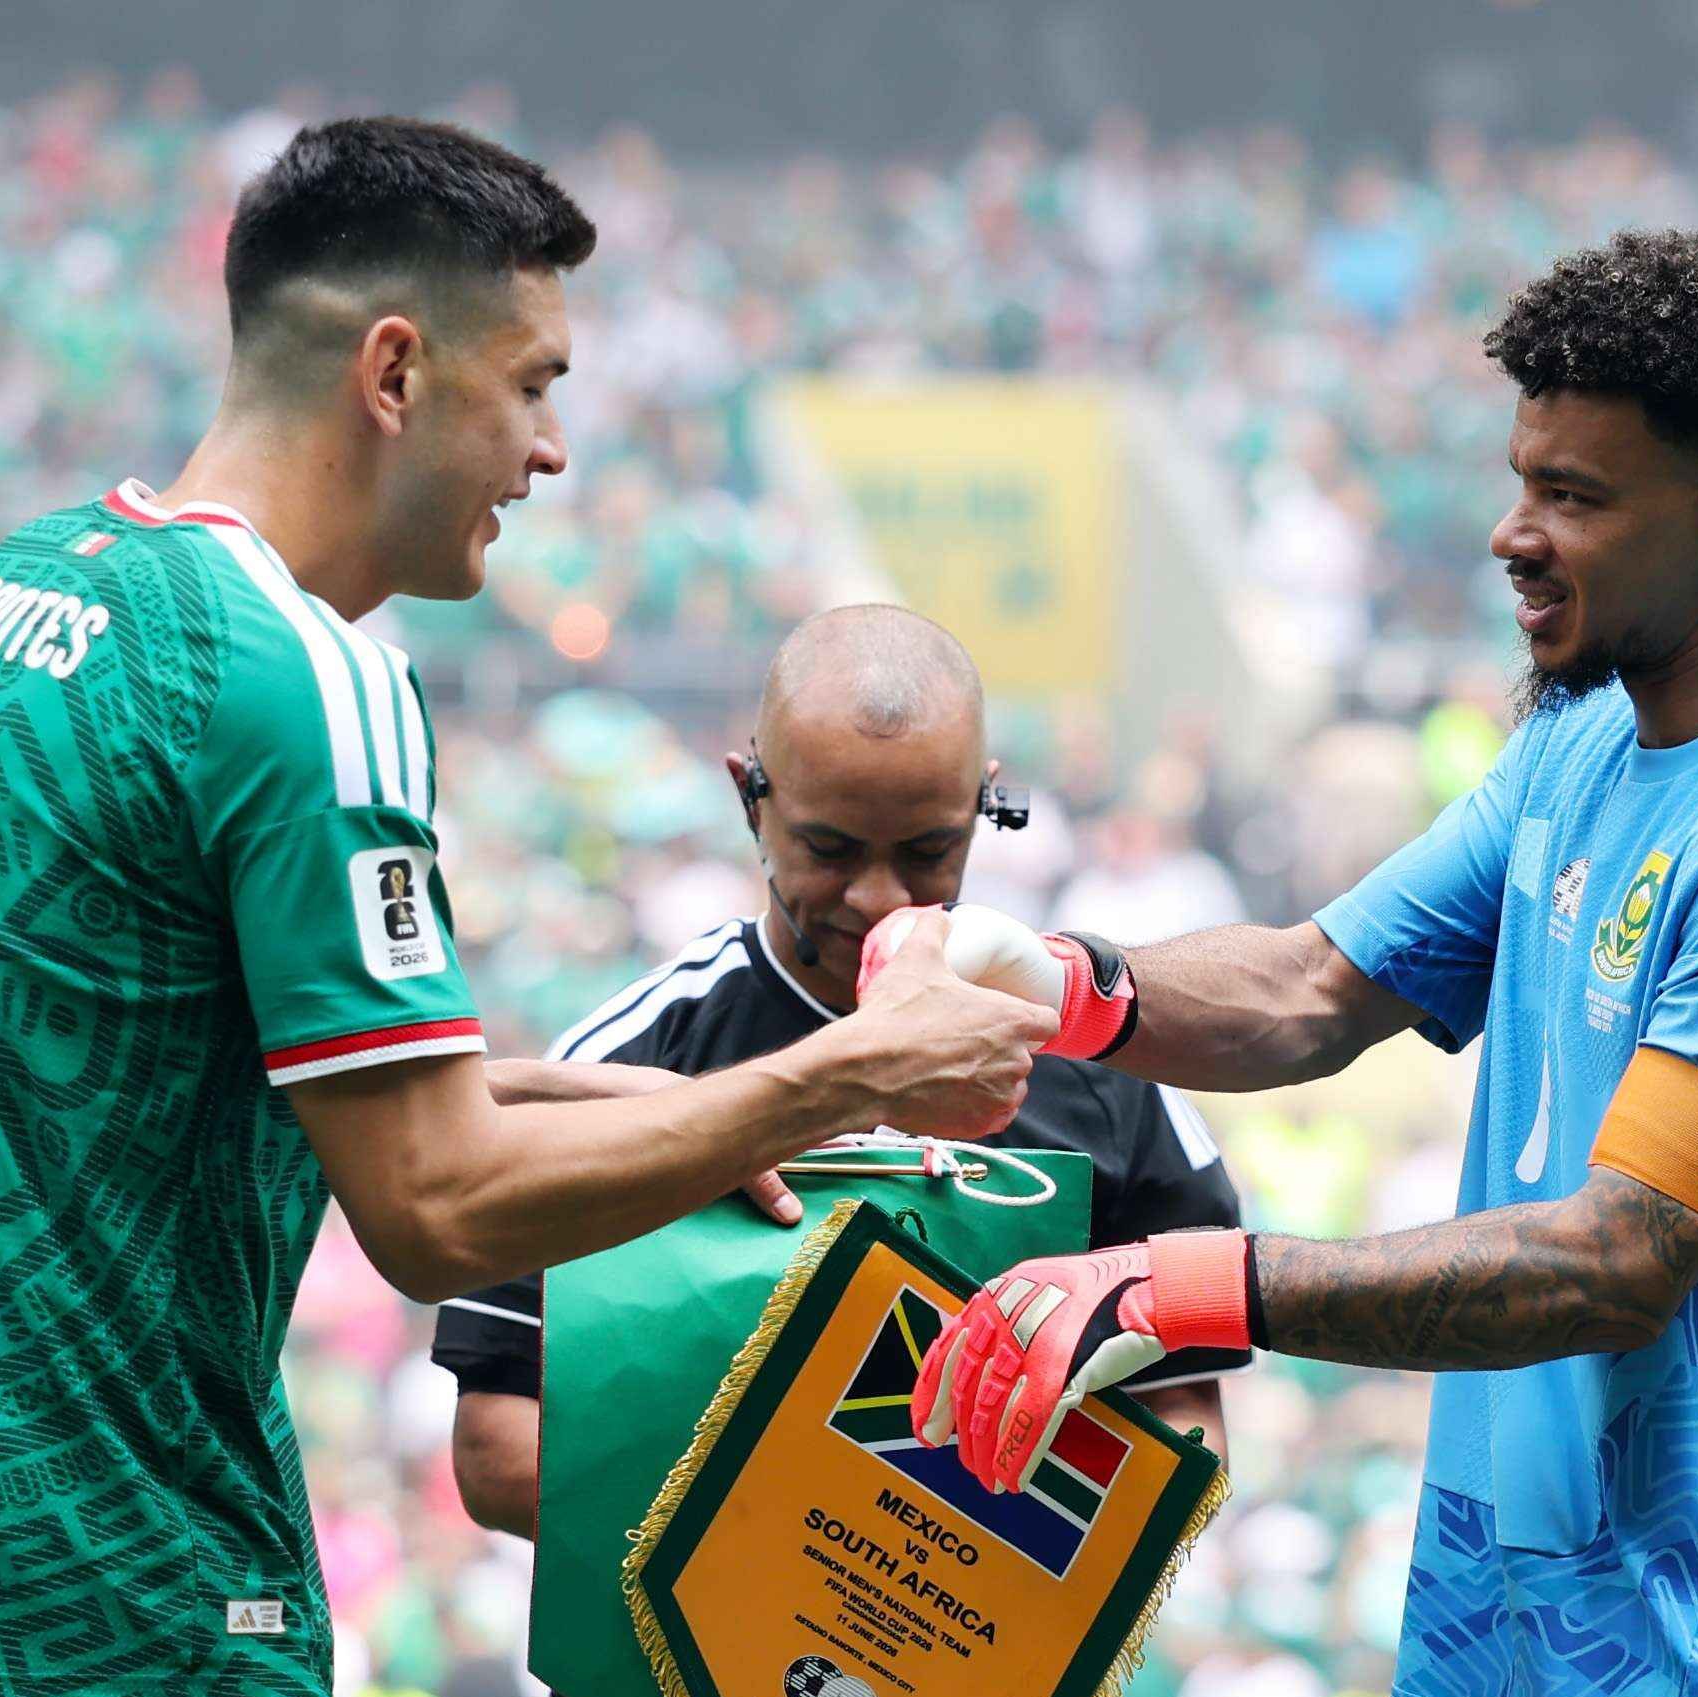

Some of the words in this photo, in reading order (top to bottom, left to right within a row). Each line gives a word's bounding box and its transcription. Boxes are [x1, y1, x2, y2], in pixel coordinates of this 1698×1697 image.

[390, 952, 429, 967] 2026
[875, 1488, 979, 1566] MEXICO
[905, 1539, 929, 1564] VS
[804, 1508, 900, 1577] SOUTH
[899, 1570, 996, 1645] AFRICA
[803, 1545, 847, 1577] SENIOR
[847, 1571, 883, 1600] MEN'S
[883, 1595, 937, 1638] NATIONAL
[940, 1631, 971, 1659] TEAM
[824, 1577, 847, 1598] FIFA
[849, 1592, 886, 1622] WORLD
[887, 1617, 909, 1638] CUP
[848, 1621, 875, 1643] JUNE
[875, 1638, 899, 1659] 2026
[898, 1678, 916, 1694] CITY
